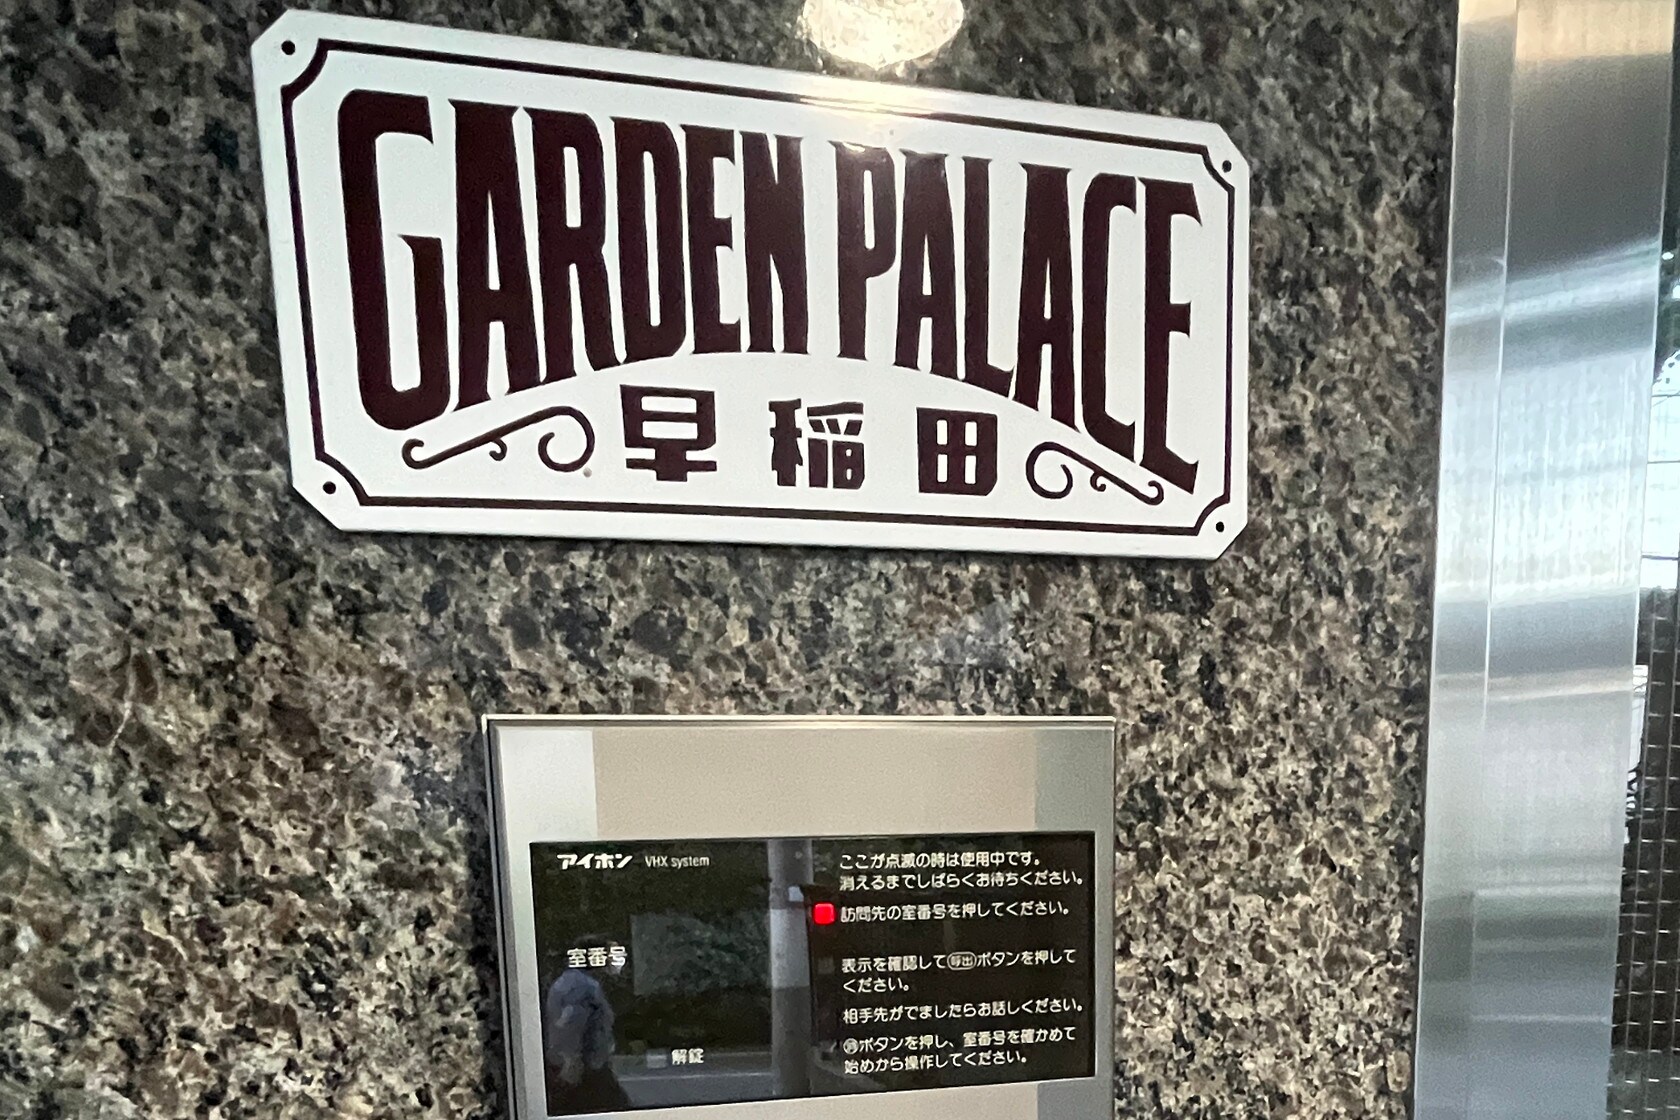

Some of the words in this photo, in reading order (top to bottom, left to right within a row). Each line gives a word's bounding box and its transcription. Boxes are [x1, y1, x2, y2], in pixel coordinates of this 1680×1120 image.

[337, 89, 810, 431] GARDEN
[828, 140, 1203, 495] PALACE
[619, 384, 998, 496] 早稲田
[557, 853, 633, 870] アイホン
[645, 856, 668, 867] VHX
[671, 856, 710, 869] system
[839, 851, 1040, 869] ここが点滅の時は使用中です。
[839, 870, 1083, 891] 消えるまでしばらくお待ちください。
[840, 901, 1069, 922] 訪問先の室番号を押してください。
[567, 946, 628, 968] 室番号
[843, 977, 910, 993] ください。
[843, 998, 1083, 1024] 相手先がでましたらお話しください。
[844, 1050, 1027, 1074] 始めから操作してください。
